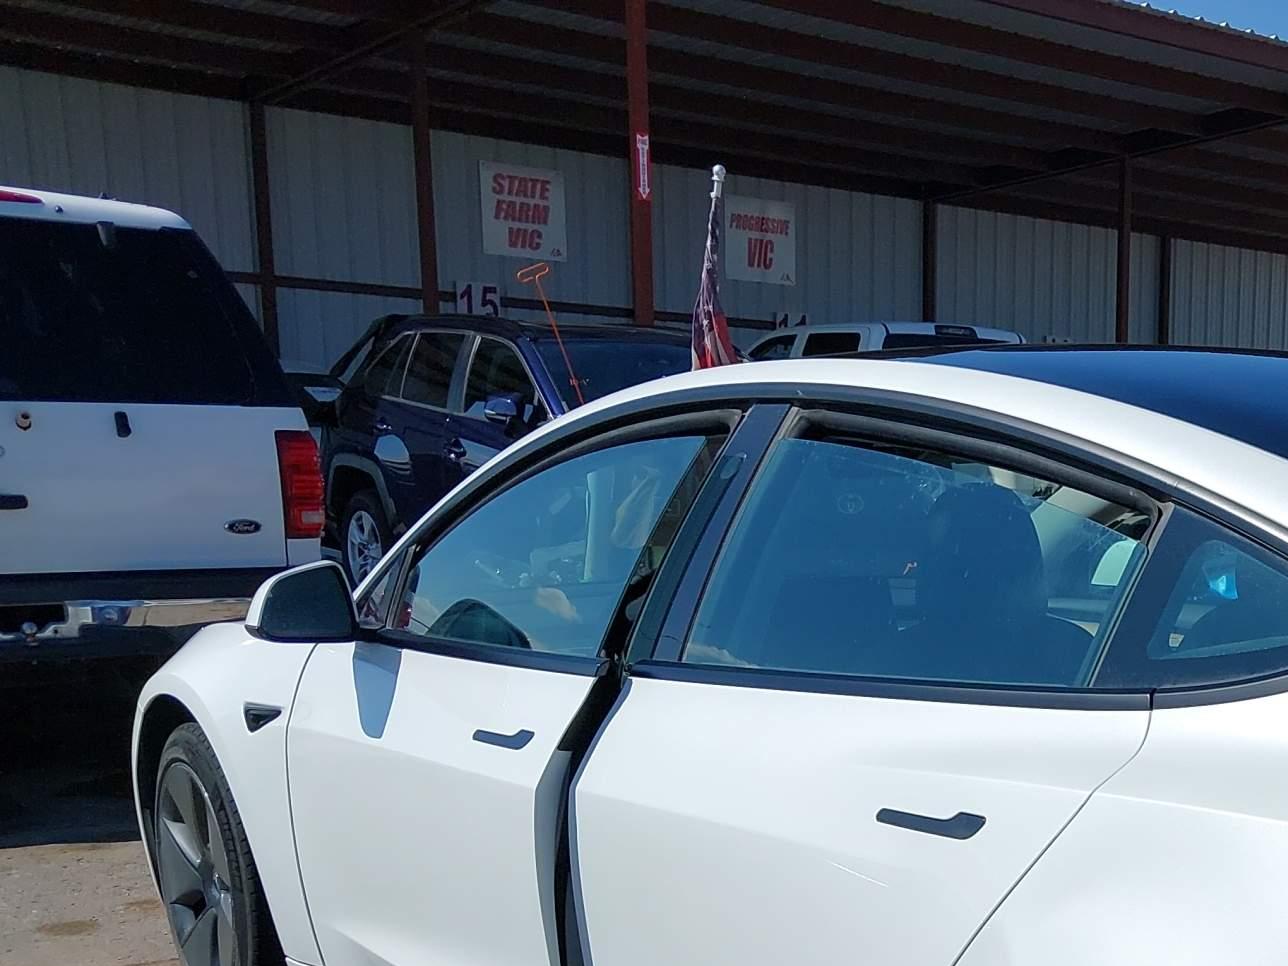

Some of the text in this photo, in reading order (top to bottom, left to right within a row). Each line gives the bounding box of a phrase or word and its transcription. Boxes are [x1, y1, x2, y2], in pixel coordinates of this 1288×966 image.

[492, 173, 552, 200] STATE
[494, 199, 551, 225] FARM
[730, 212, 790, 236] PROGRESSIVE
[508, 227, 543, 251] VIC
[747, 237, 774, 270] VIC
[460, 283, 499, 317] 15
